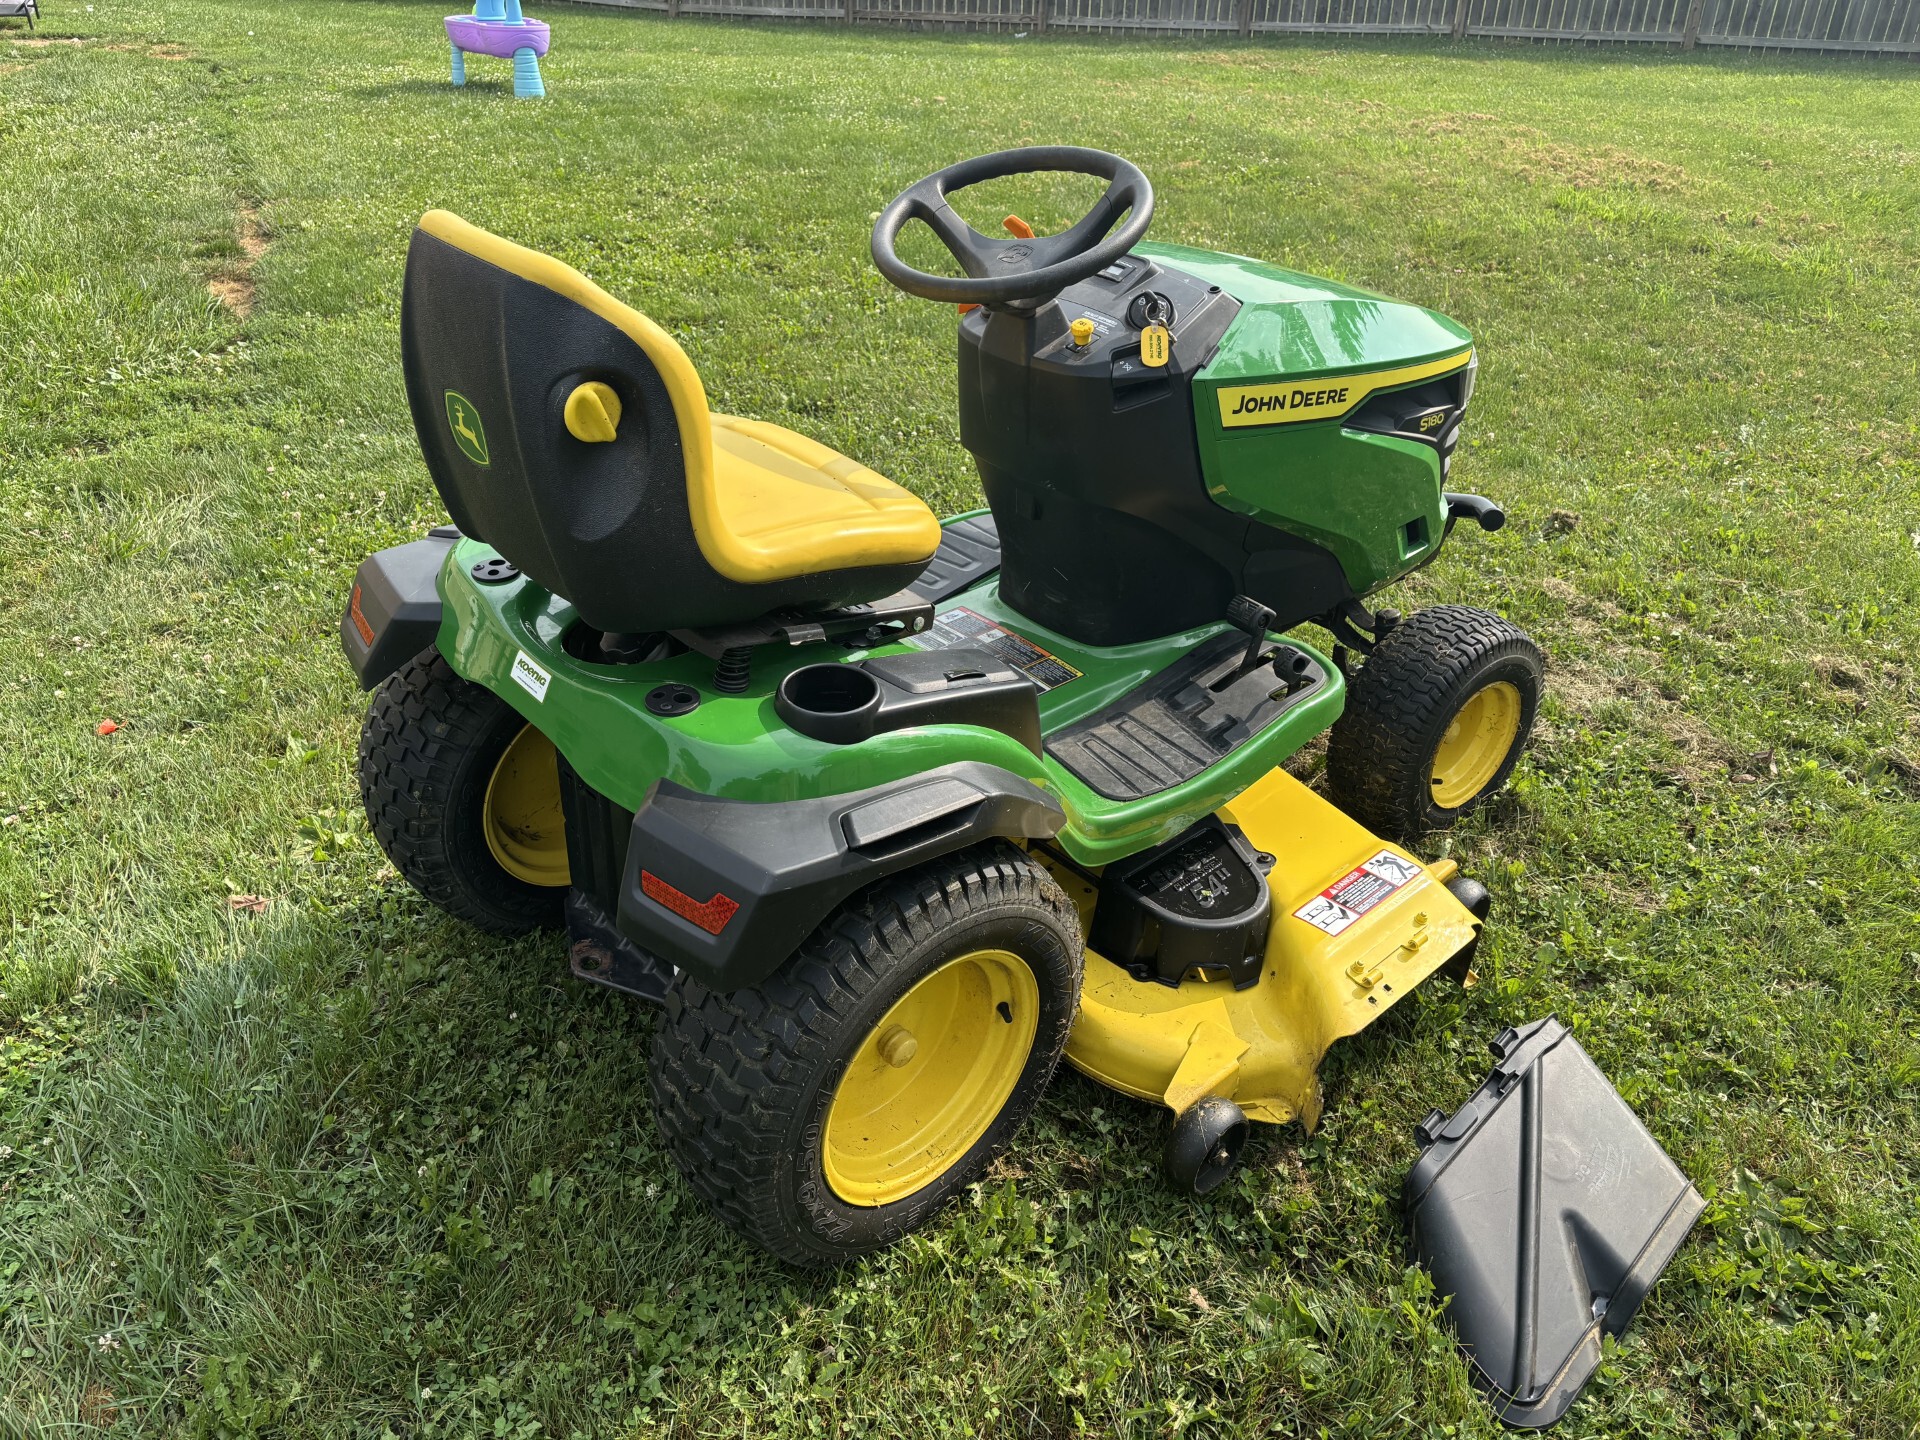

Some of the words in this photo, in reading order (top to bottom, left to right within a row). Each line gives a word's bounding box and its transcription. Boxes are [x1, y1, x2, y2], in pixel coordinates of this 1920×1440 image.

[1232, 394, 1286, 414] JOHN
[1290, 387, 1349, 408] DEERE
[1420, 412, 1445, 431] S180
[1335, 871, 1361, 890] DANGER
[1014, 921, 1072, 1011] KENDA
